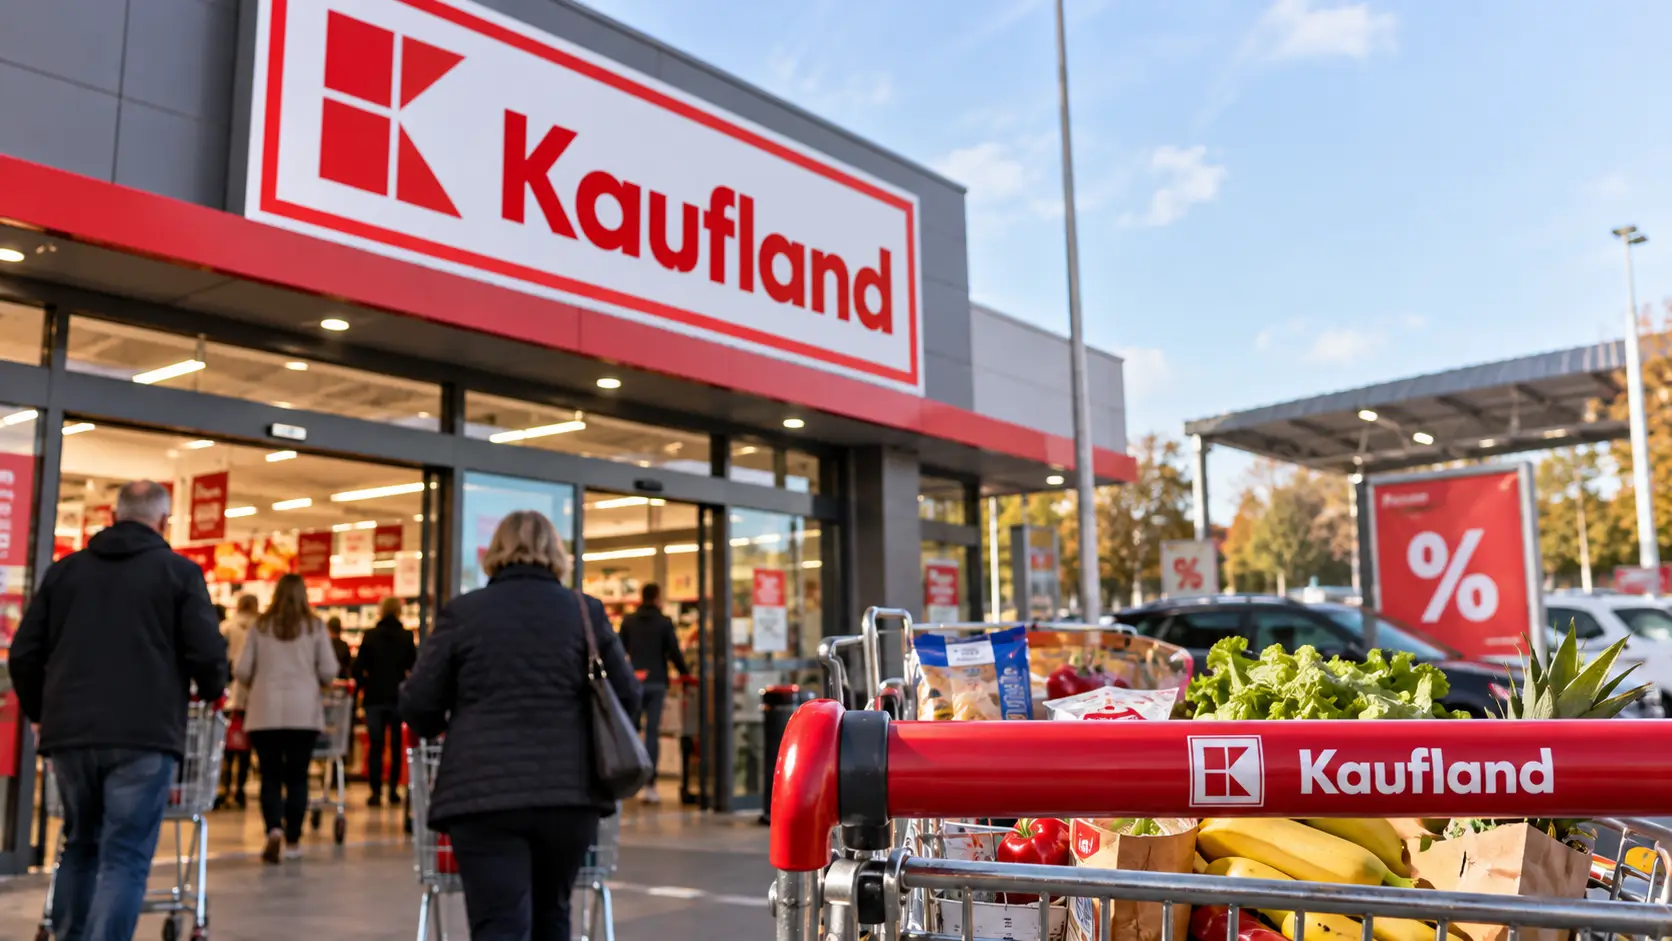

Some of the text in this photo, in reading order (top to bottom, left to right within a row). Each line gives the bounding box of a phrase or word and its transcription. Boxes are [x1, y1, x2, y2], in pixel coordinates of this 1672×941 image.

[319, 9, 467, 219] K
[501, 108, 893, 335] Kaufland
[1173, 556, 1204, 590] %
[1408, 528, 1499, 622] %
[1203, 746, 1252, 797] K
[1299, 747, 1555, 795] Kaufland
